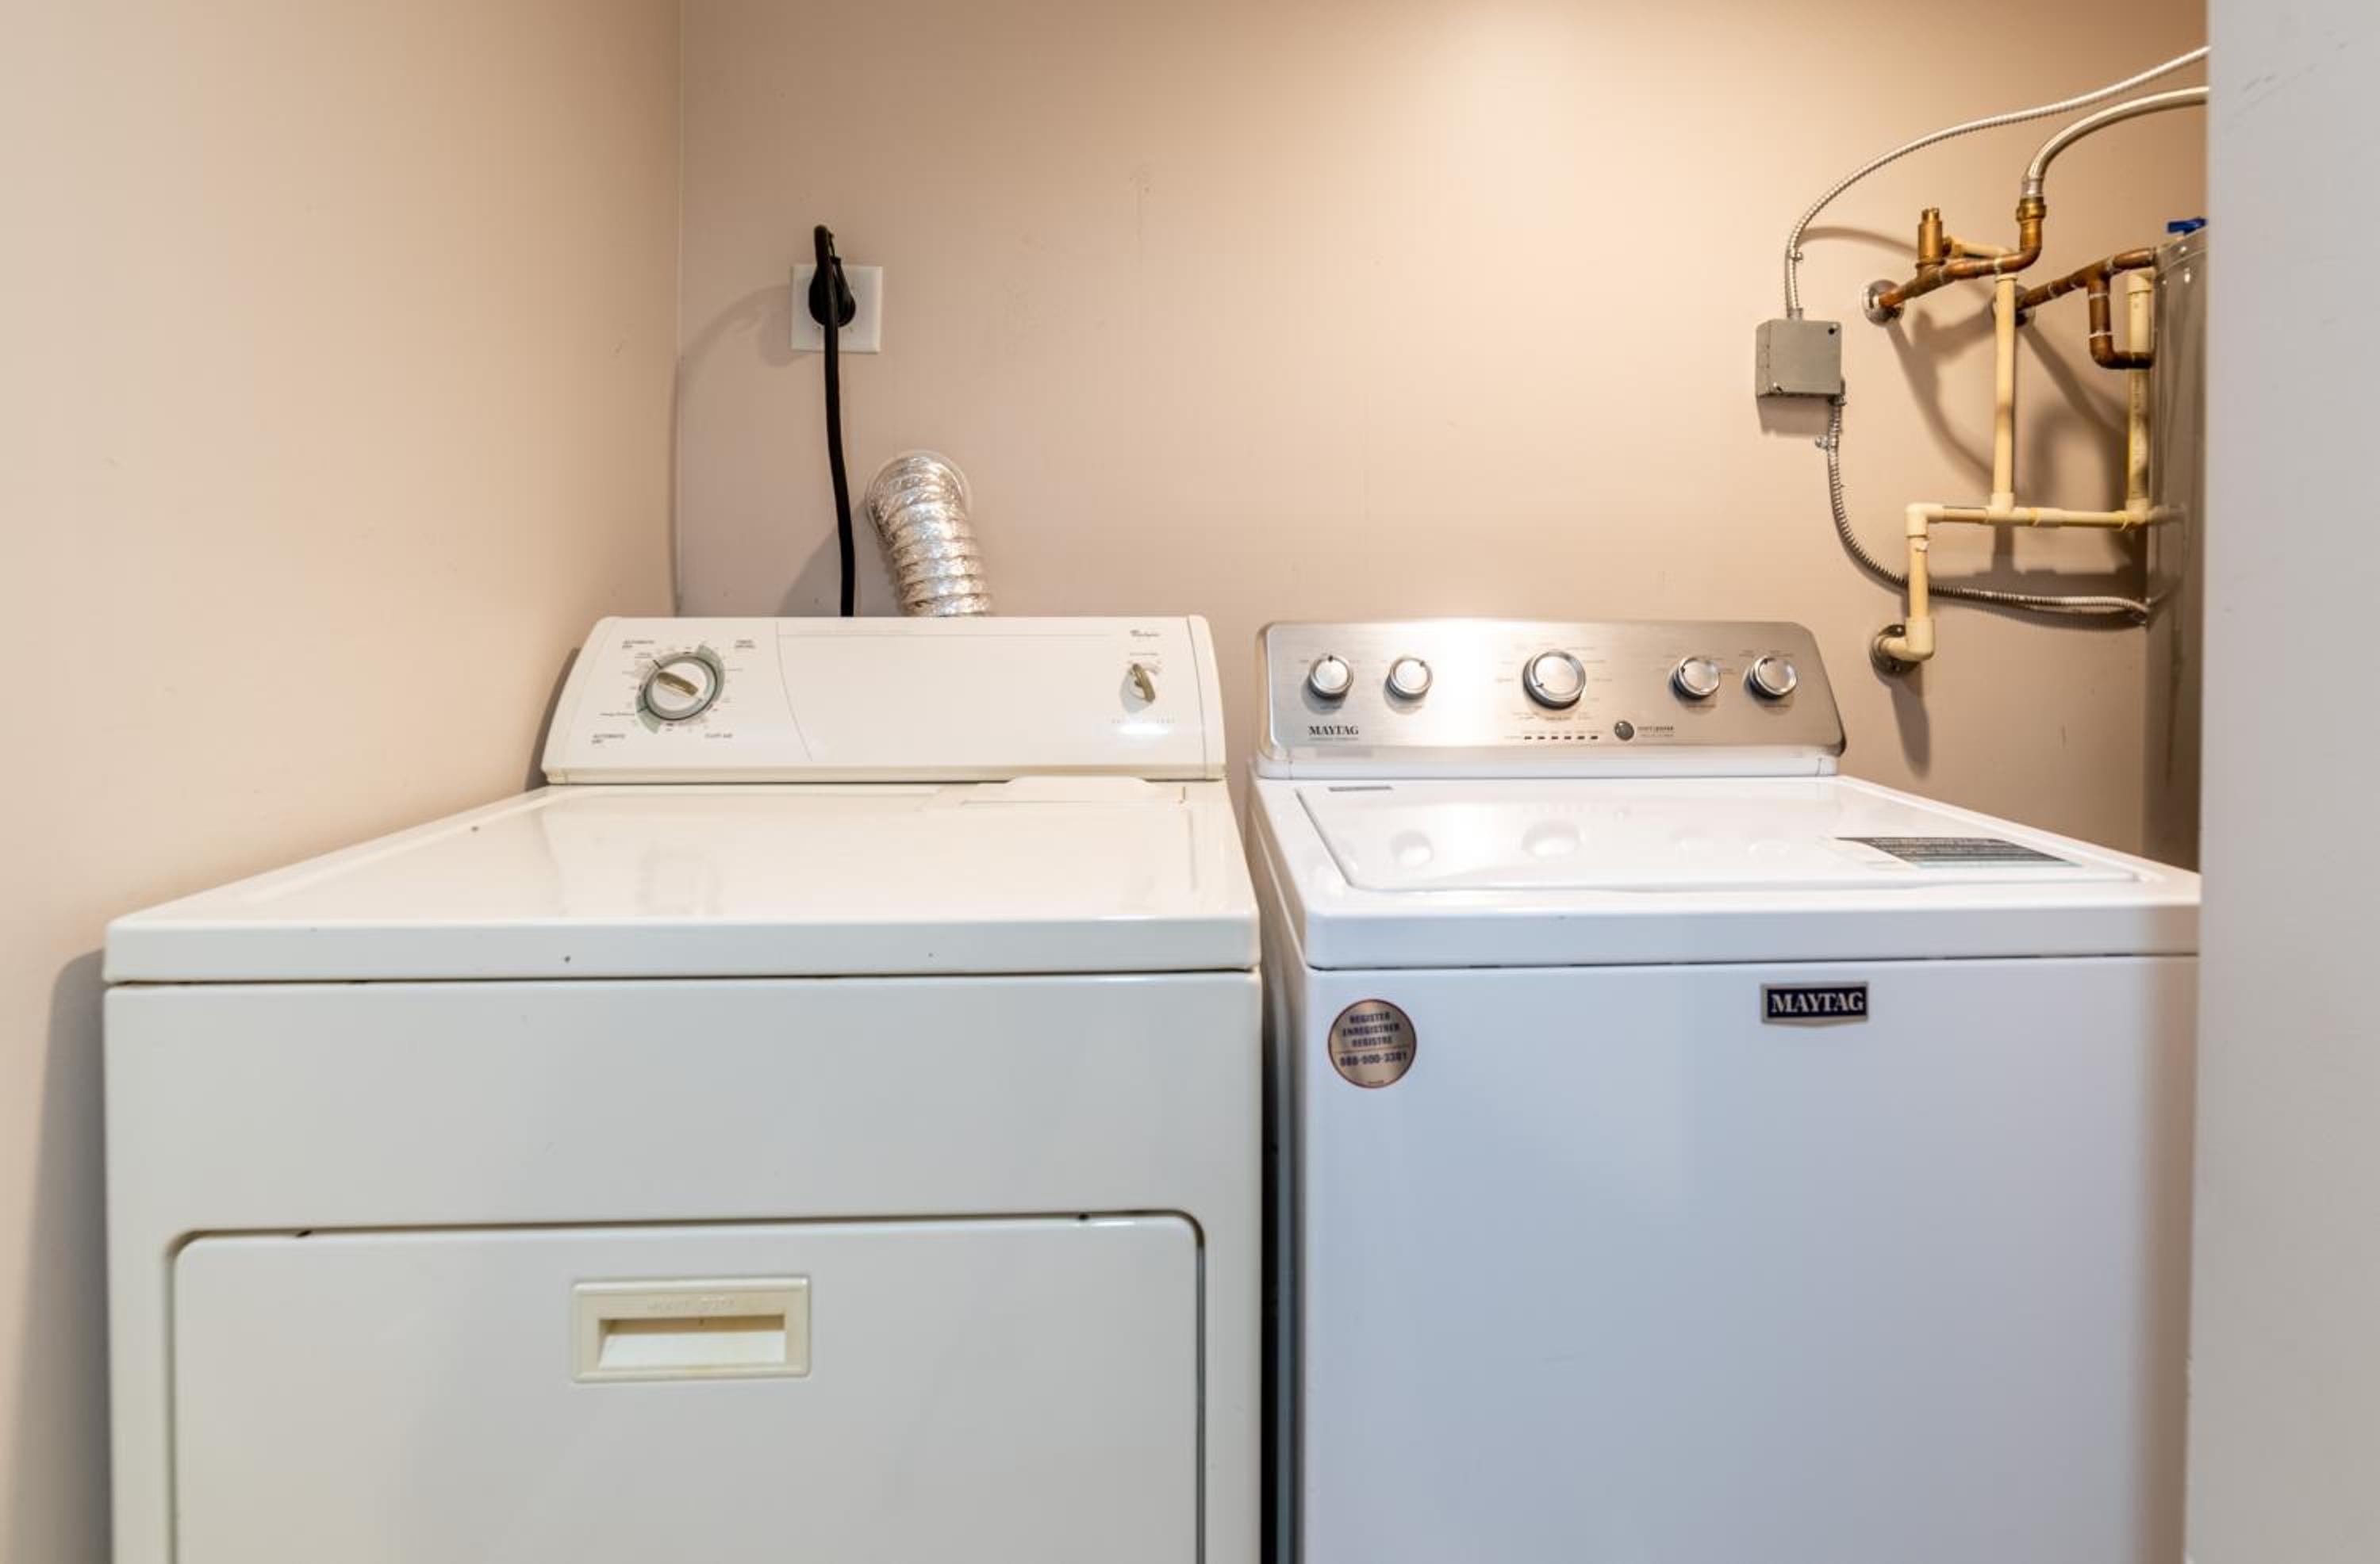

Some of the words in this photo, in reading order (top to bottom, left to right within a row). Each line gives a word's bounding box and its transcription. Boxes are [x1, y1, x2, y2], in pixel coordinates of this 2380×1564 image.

[1308, 725, 1359, 736] MAYTAG
[1770, 991, 1864, 1013] MAYTAG
[1349, 1011, 1390, 1024] REGISTER
[1342, 1023, 1400, 1037] ENREGISTRER
